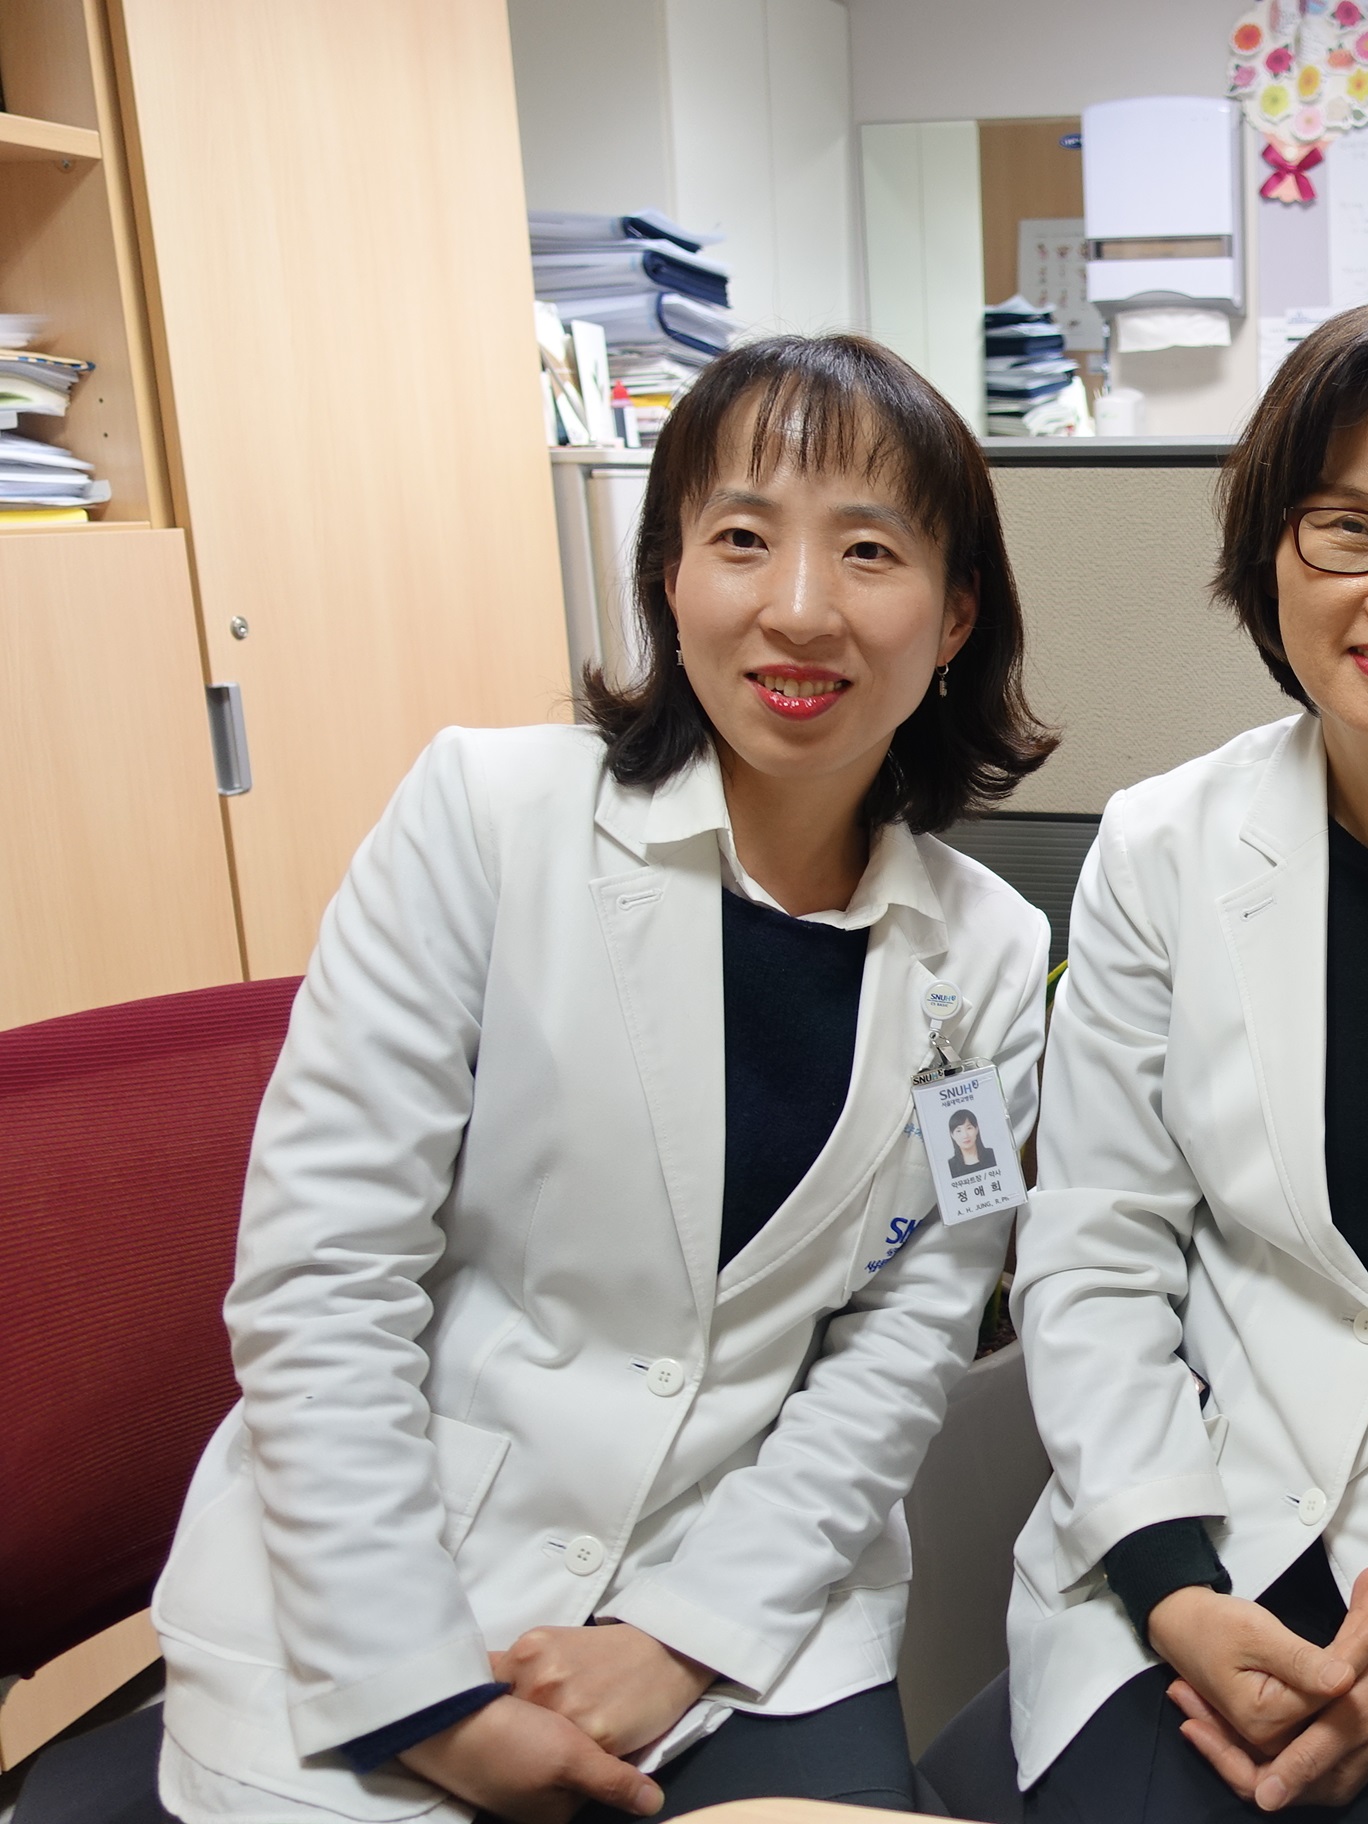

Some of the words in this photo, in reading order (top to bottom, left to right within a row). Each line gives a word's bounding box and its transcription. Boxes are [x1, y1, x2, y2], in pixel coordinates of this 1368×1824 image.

[930, 993, 952, 1001] SNUH
[913, 1072, 939, 1086] SNUH
[939, 1083, 973, 1101] SNUH
